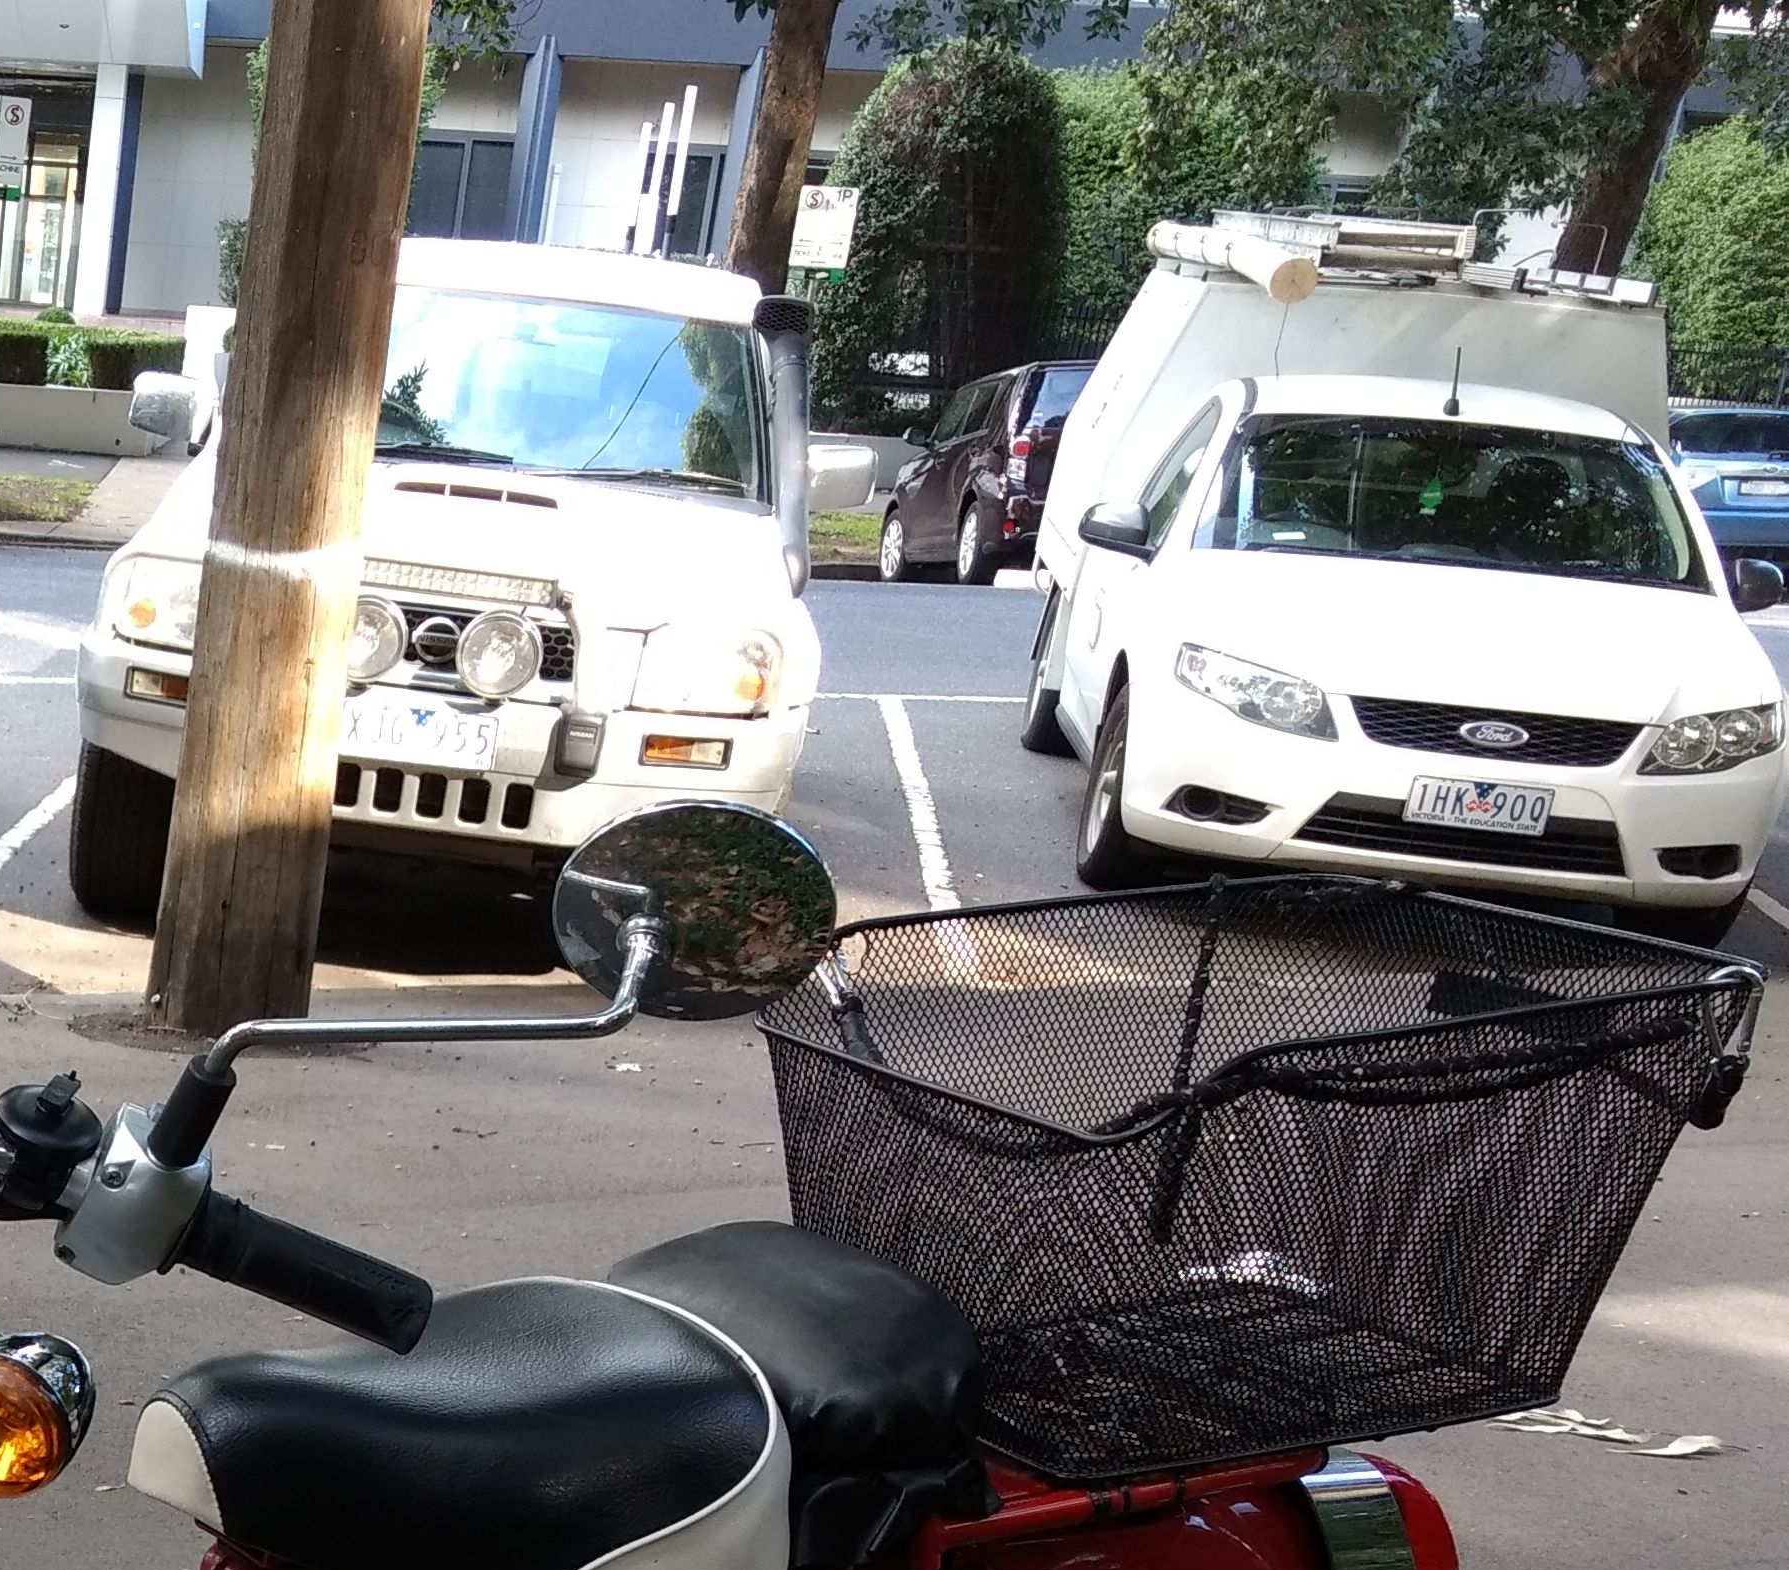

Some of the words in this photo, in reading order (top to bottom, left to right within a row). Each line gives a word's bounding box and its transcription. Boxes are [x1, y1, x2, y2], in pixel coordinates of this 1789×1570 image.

[836, 188, 853, 203] 1P
[1476, 725, 1513, 742] Ford
[1417, 783, 1469, 816] 1HK
[1411, 811, 1445, 823] VICTORIA
[1469, 818, 1516, 830] EDUCATION
[1516, 823, 1538, 832] STATE
